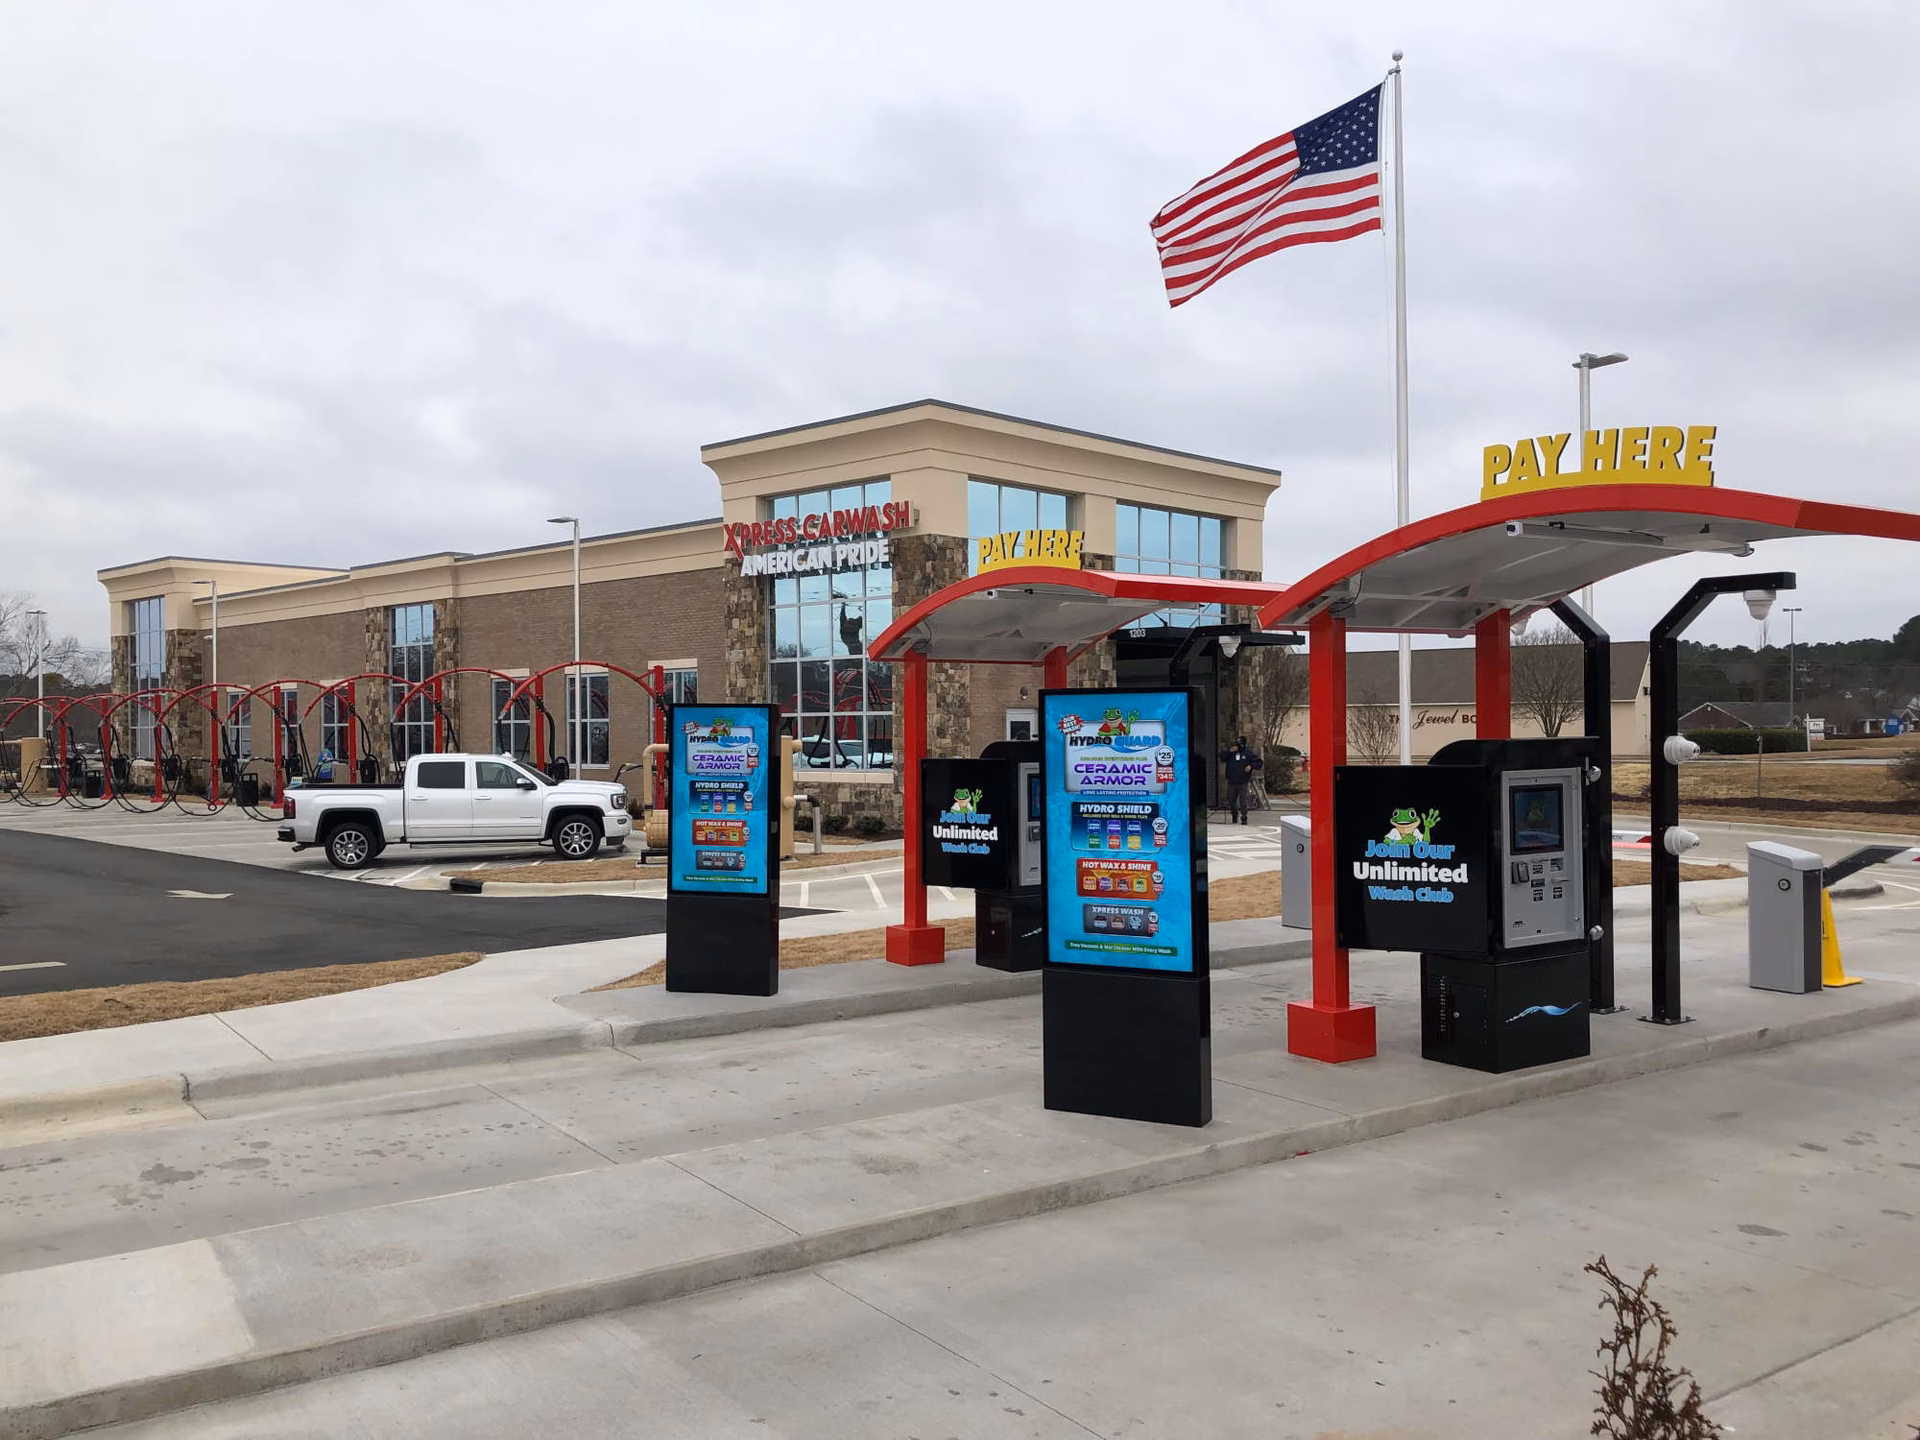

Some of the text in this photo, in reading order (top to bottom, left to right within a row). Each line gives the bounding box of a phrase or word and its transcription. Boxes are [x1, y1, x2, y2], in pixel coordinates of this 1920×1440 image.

[1482, 425, 1717, 487] PAY HERE
[723, 500, 911, 558] XPRESS CARWASH
[981, 529, 1085, 565] PAY HERE
[740, 538, 890, 577] AMERICAN PRIDE
[1129, 629, 1146, 638] 1203
[1412, 708, 1459, 730] Jewel
[1462, 714, 1477, 724] BO
[689, 735, 719, 743] HYDRO
[1069, 735, 1162, 747] HYDRO GUARD
[692, 754, 745, 762] CERAMIC
[1074, 763, 1153, 774] CERAMIC
[1080, 775, 1147, 785] ARMOR
[1080, 804, 1152, 814] HYDRO SHIELD
[940, 810, 991, 824] Join Our
[932, 825, 998, 841] Unlimited
[941, 842, 991, 855] Wash Club
[1365, 839, 1456, 860] Join Our
[1082, 861, 1099, 869] HOT
[1120, 862, 1126, 870] &
[1352, 861, 1469, 884] Unlimited
[1368, 885, 1454, 903] Wash Club
[1091, 906, 1144, 915] XPRESS WASH
